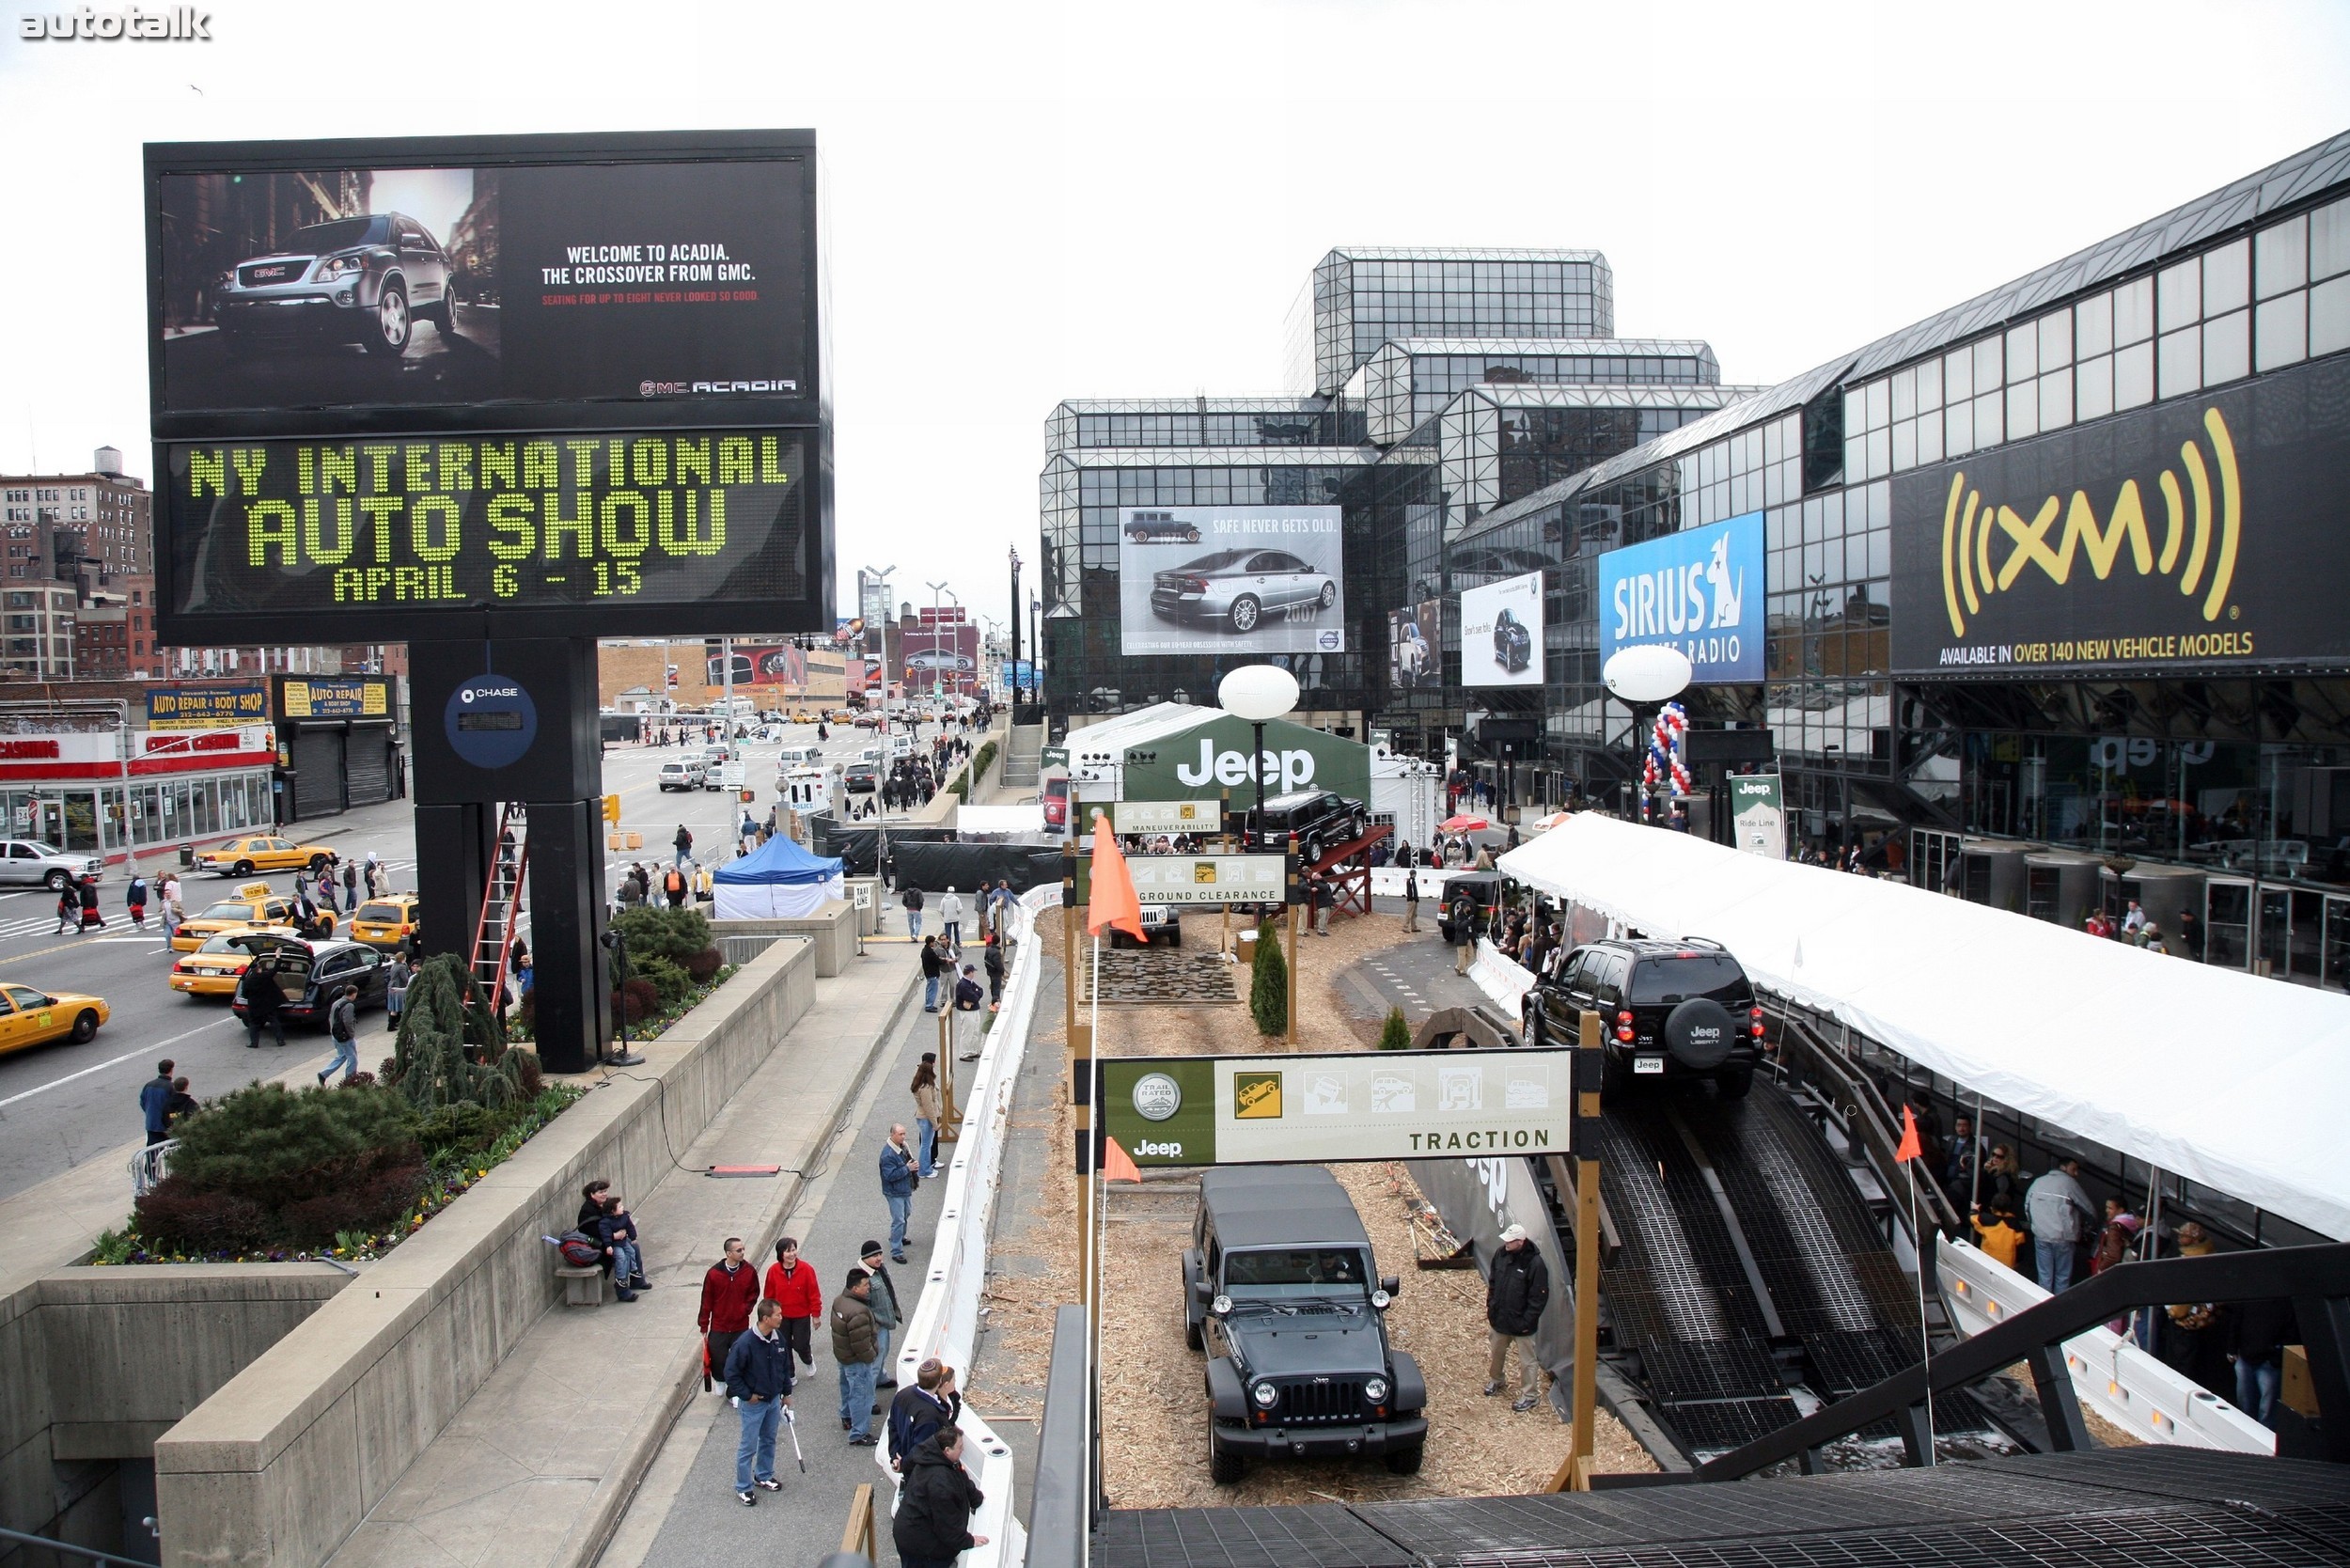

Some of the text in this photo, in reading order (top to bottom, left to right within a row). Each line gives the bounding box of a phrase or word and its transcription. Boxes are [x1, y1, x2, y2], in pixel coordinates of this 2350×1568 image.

[567, 243, 729, 263] WELCOME TO ACADIA.
[542, 263, 756, 285] THE CROSSOVER FROM GMC.
[541, 290, 760, 306] SEATING FOR UP TO EIGHT NEVER LOOKED SO GOOD.
[692, 379, 796, 393] ACADIA
[190, 435, 789, 496] NY INTERNATIONAL
[246, 488, 726, 566] AUTO SHOW
[1213, 518, 1337, 534] SAFE NEVER GETS OLD.
[1998, 478, 2153, 591] XM
[333, 564, 466, 602] APRIL
[493, 563, 519, 597] 6
[593, 561, 643, 596] 15
[1614, 562, 1705, 640] SIRIUS
[1283, 606, 1317, 623] 2007
[1687, 635, 1740, 665] RADIO
[1939, 632, 2252, 665] AVAILABLE IN OVER 140 NEW VEHICLE MODELS
[311, 687, 334, 702] AUTO
[336, 687, 363, 702] REPAIR
[476, 687, 518, 698] CHASE
[153, 695, 176, 714] AUTO
[178, 696, 207, 711] REPAIR
[214, 696, 238, 710] BODY
[240, 692, 262, 712] SHOP
[1046, 751, 1065, 760] Jeep
[1177, 739, 1315, 794] Jeep
[1739, 782, 1770, 795] Jeep
[1132, 823, 1214, 833] MANEUVERABILITY
[1740, 819, 1775, 827] Ride Line
[856, 886, 869, 895] TAXI
[1139, 890, 1277, 902] GROUND CLEARANCE
[856, 897, 868, 905] LINE
[1690, 1026, 1720, 1038] Jeep
[1637, 1061, 1660, 1070] Jeep
[1410, 1128, 1550, 1151] TRACTION
[1134, 1139, 1183, 1158] Jeep
